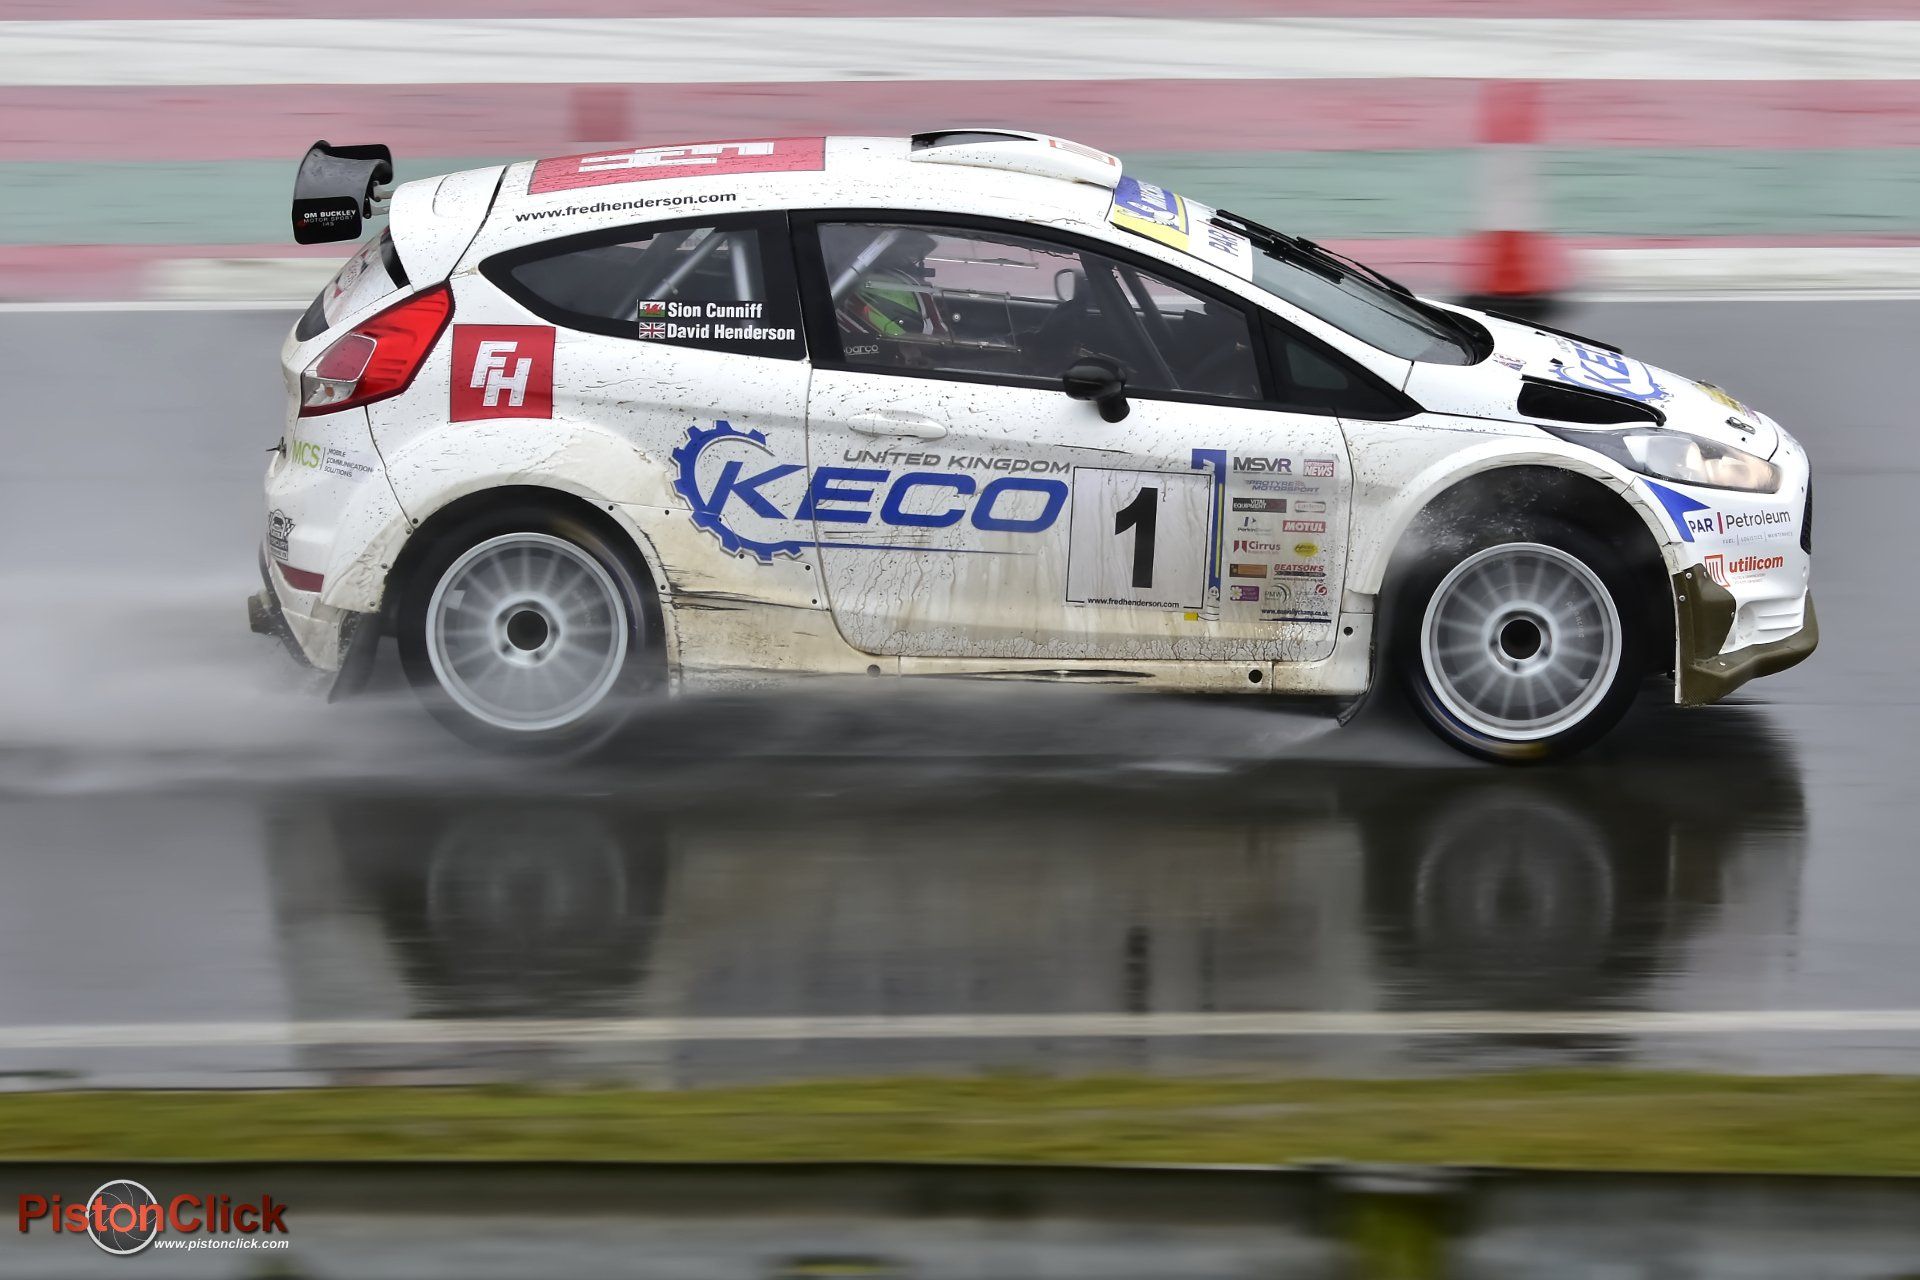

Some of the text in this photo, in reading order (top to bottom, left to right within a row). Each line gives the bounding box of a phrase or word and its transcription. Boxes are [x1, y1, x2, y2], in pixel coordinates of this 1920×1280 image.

[319, 209, 356, 218] BUCKLEY
[515, 192, 737, 223] www.fredhenderson.com
[667, 302, 763, 319] Sion Cunniff
[667, 323, 796, 341] David Henderson
[292, 440, 321, 469] MCS
[327, 448, 347, 458] MOBILE
[843, 449, 1071, 475] UNITED KINGDOM
[1233, 456, 1292, 473] MSVR
[324, 466, 353, 478] SOLUTIONS
[1303, 465, 1334, 477] NEWS
[703, 460, 1070, 534] KECO
[1252, 485, 1320, 493] MOTORSPORT
[1284, 520, 1325, 532] MOTUL
[1688, 509, 1791, 533] PAR Petroleum
[1115, 486, 1158, 588] 1
[1248, 541, 1281, 551] Cirrus
[1729, 555, 1784, 573] utilicom
[1087, 597, 1180, 609] www.fredhenderson.com
